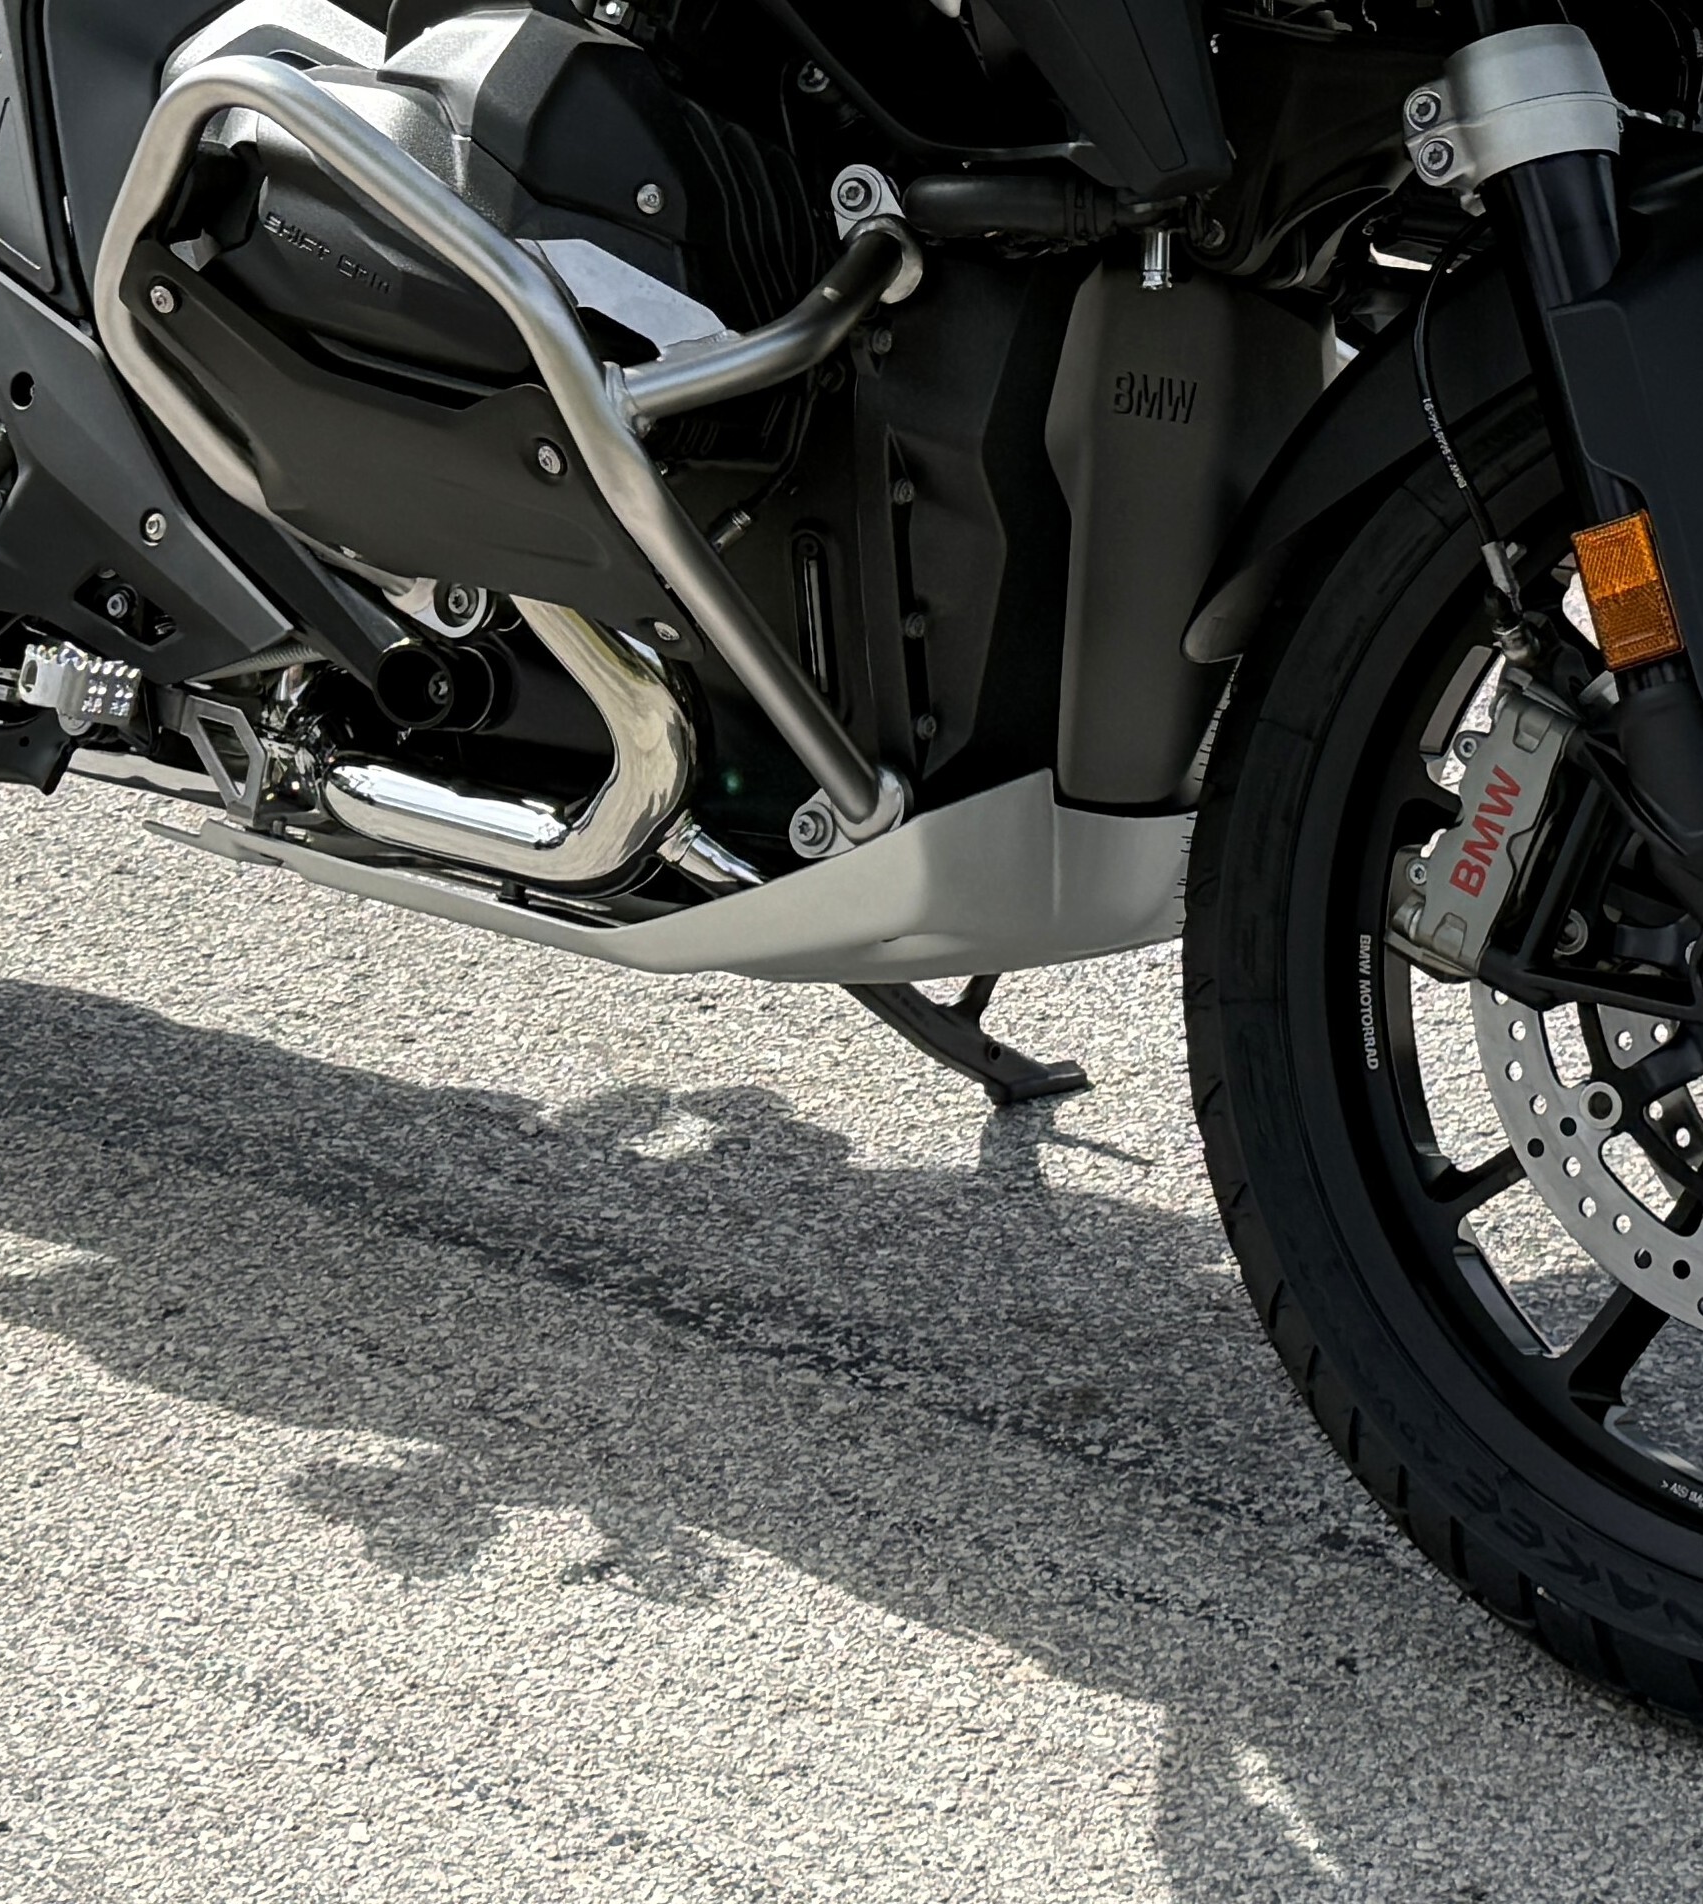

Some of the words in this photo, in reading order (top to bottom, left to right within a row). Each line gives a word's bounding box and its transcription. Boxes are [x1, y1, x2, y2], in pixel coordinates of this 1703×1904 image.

[1111, 370, 1198, 425] BMW
[1449, 764, 1522, 897] BMW
[1358, 934, 1372, 975] BMW
[1358, 979, 1379, 1071] MOTORRAD
